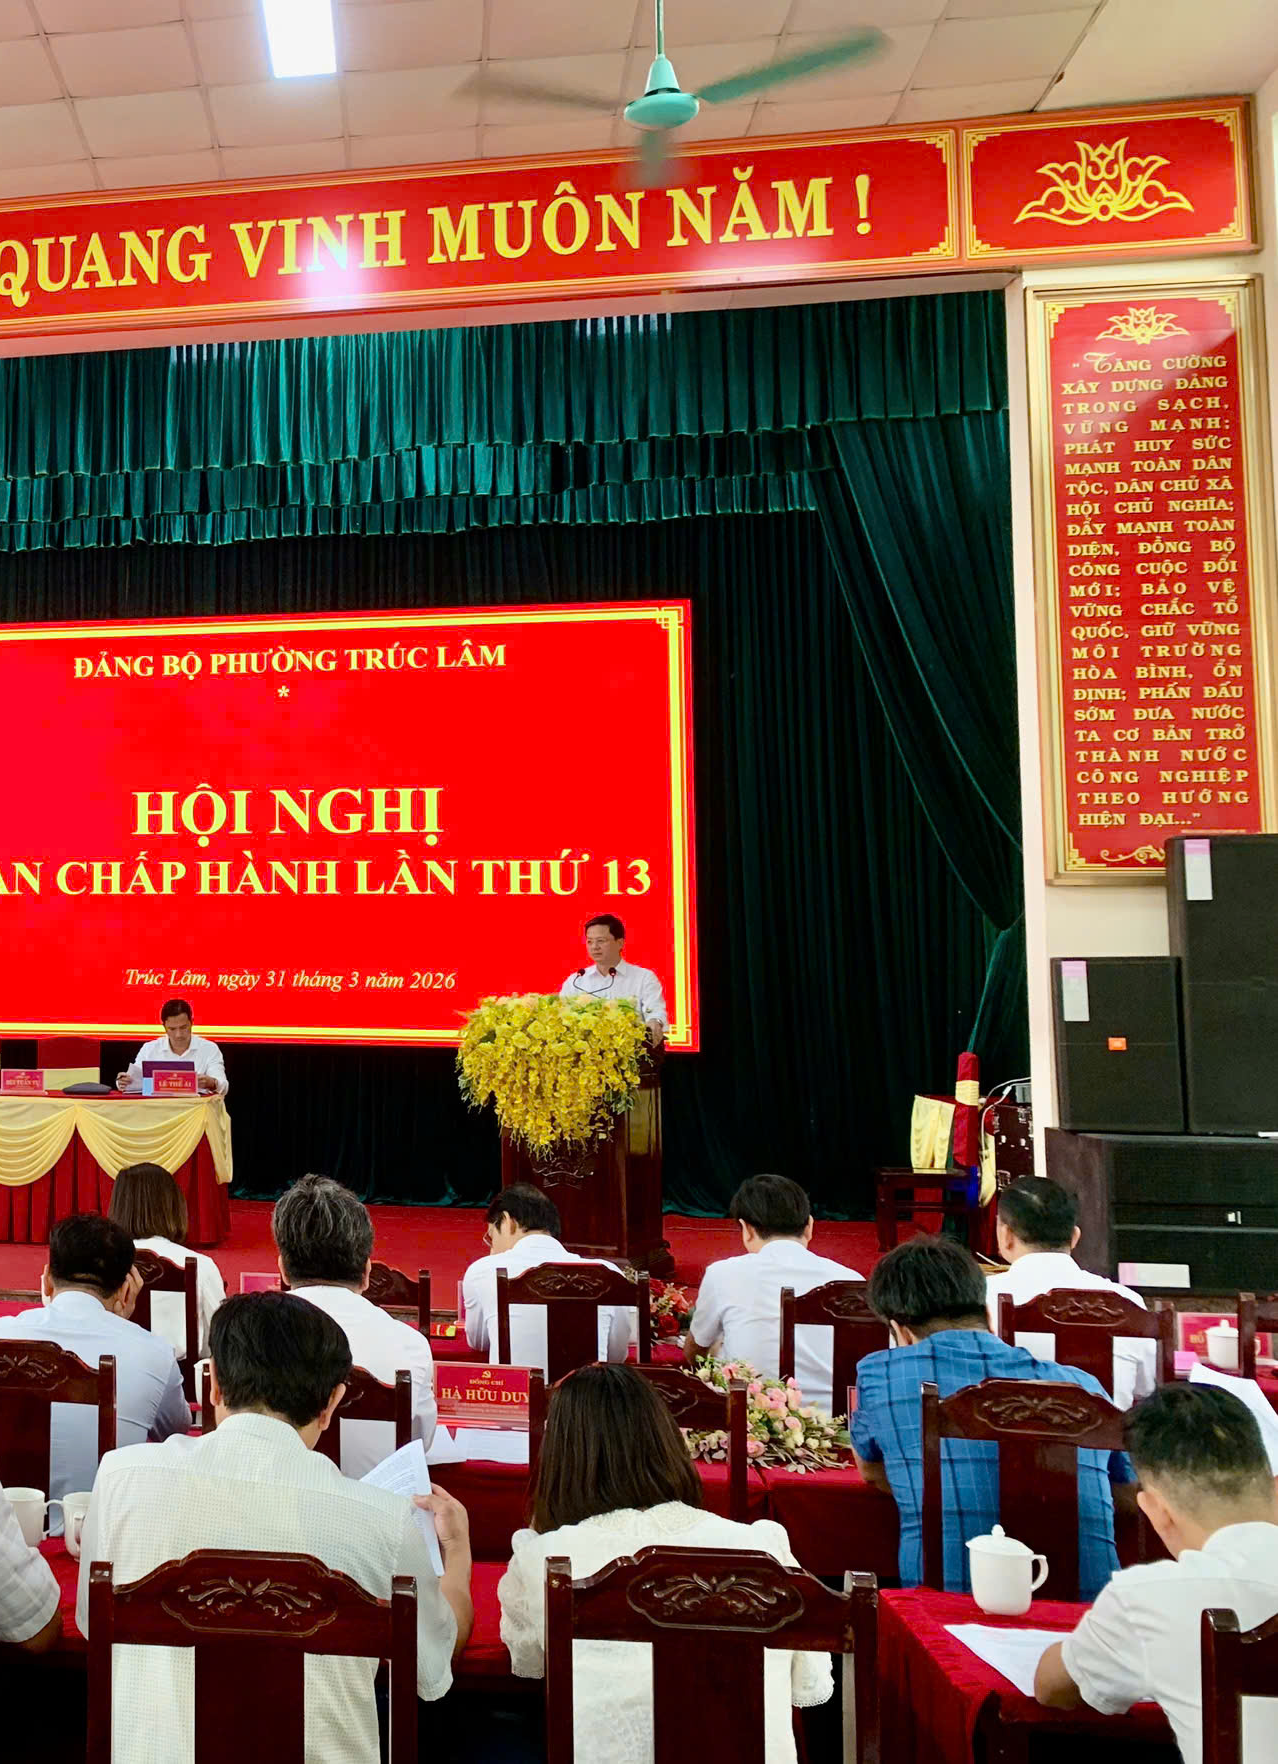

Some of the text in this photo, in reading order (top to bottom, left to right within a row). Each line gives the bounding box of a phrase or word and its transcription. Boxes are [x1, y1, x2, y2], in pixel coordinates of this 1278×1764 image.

[230, 210, 406, 278] VINH
[427, 181, 645, 264] MUÔN
[666, 165, 834, 246] NĂM
[856, 174, 872, 234] !
[1162, 354, 1227, 370] CƯỜNG
[1062, 375, 1228, 394] XÂY DỰNG ĐẢNG
[1062, 401, 1136, 414] TRONG
[1064, 435, 1231, 454] PHÁT HUY SỨC
[1065, 455, 1232, 476] MẠNH TOÀN DÂN
[1114, 478, 1154, 493] DÂN
[1160, 476, 1199, 492] CHỦ
[1206, 478, 1234, 490] XÃ
[1066, 503, 1100, 519] HỘI
[1114, 501, 1153, 514] CHỦ
[1067, 517, 1235, 536] ĐẨY MẠNH TOÀN
[1138, 536, 1192, 554] ĐỒNG
[1210, 537, 1235, 553] BỘ
[1069, 555, 1238, 576] CÔNG CUỘC ĐỔI
[1070, 596, 1238, 617] VỮNG CHẮC TỔ
[1141, 622, 1176, 636] GIỮ
[1186, 621, 1240, 636] VỮNG
[1072, 642, 1241, 659] MÔI TRƯỜNG
[74, 642, 506, 680] ĐẢNG BỘ PHƯỜNG TRÚC LÂM
[1139, 682, 1190, 699] PHẤN
[1203, 681, 1243, 698] ĐẤU
[1074, 704, 1244, 721] SỚM ĐƯA NƯỚC
[1075, 724, 1245, 742] TA CƠ BẢN TRỞ
[1076, 746, 1246, 762] THÀNH NƯỚC
[1077, 768, 1248, 784] CÔNG NGHIỆP
[1078, 788, 1249, 804] THEO HƯỚNG
[132, 784, 443, 847] HỘI NGHỊ
[1078, 811, 1126, 827] HIỆN
[56, 852, 186, 894] CHẤP
[197, 850, 340, 894] HÀNH
[354, 850, 458, 894] LẦN
[472, 849, 589, 895] THỨ
[604, 860, 650, 895] 13
[126, 969, 456, 992] Trúc Lâm, ngày 31 tháng 3 năm 2026
[442, 1385, 529, 1403] HÀ HỮU DUY
